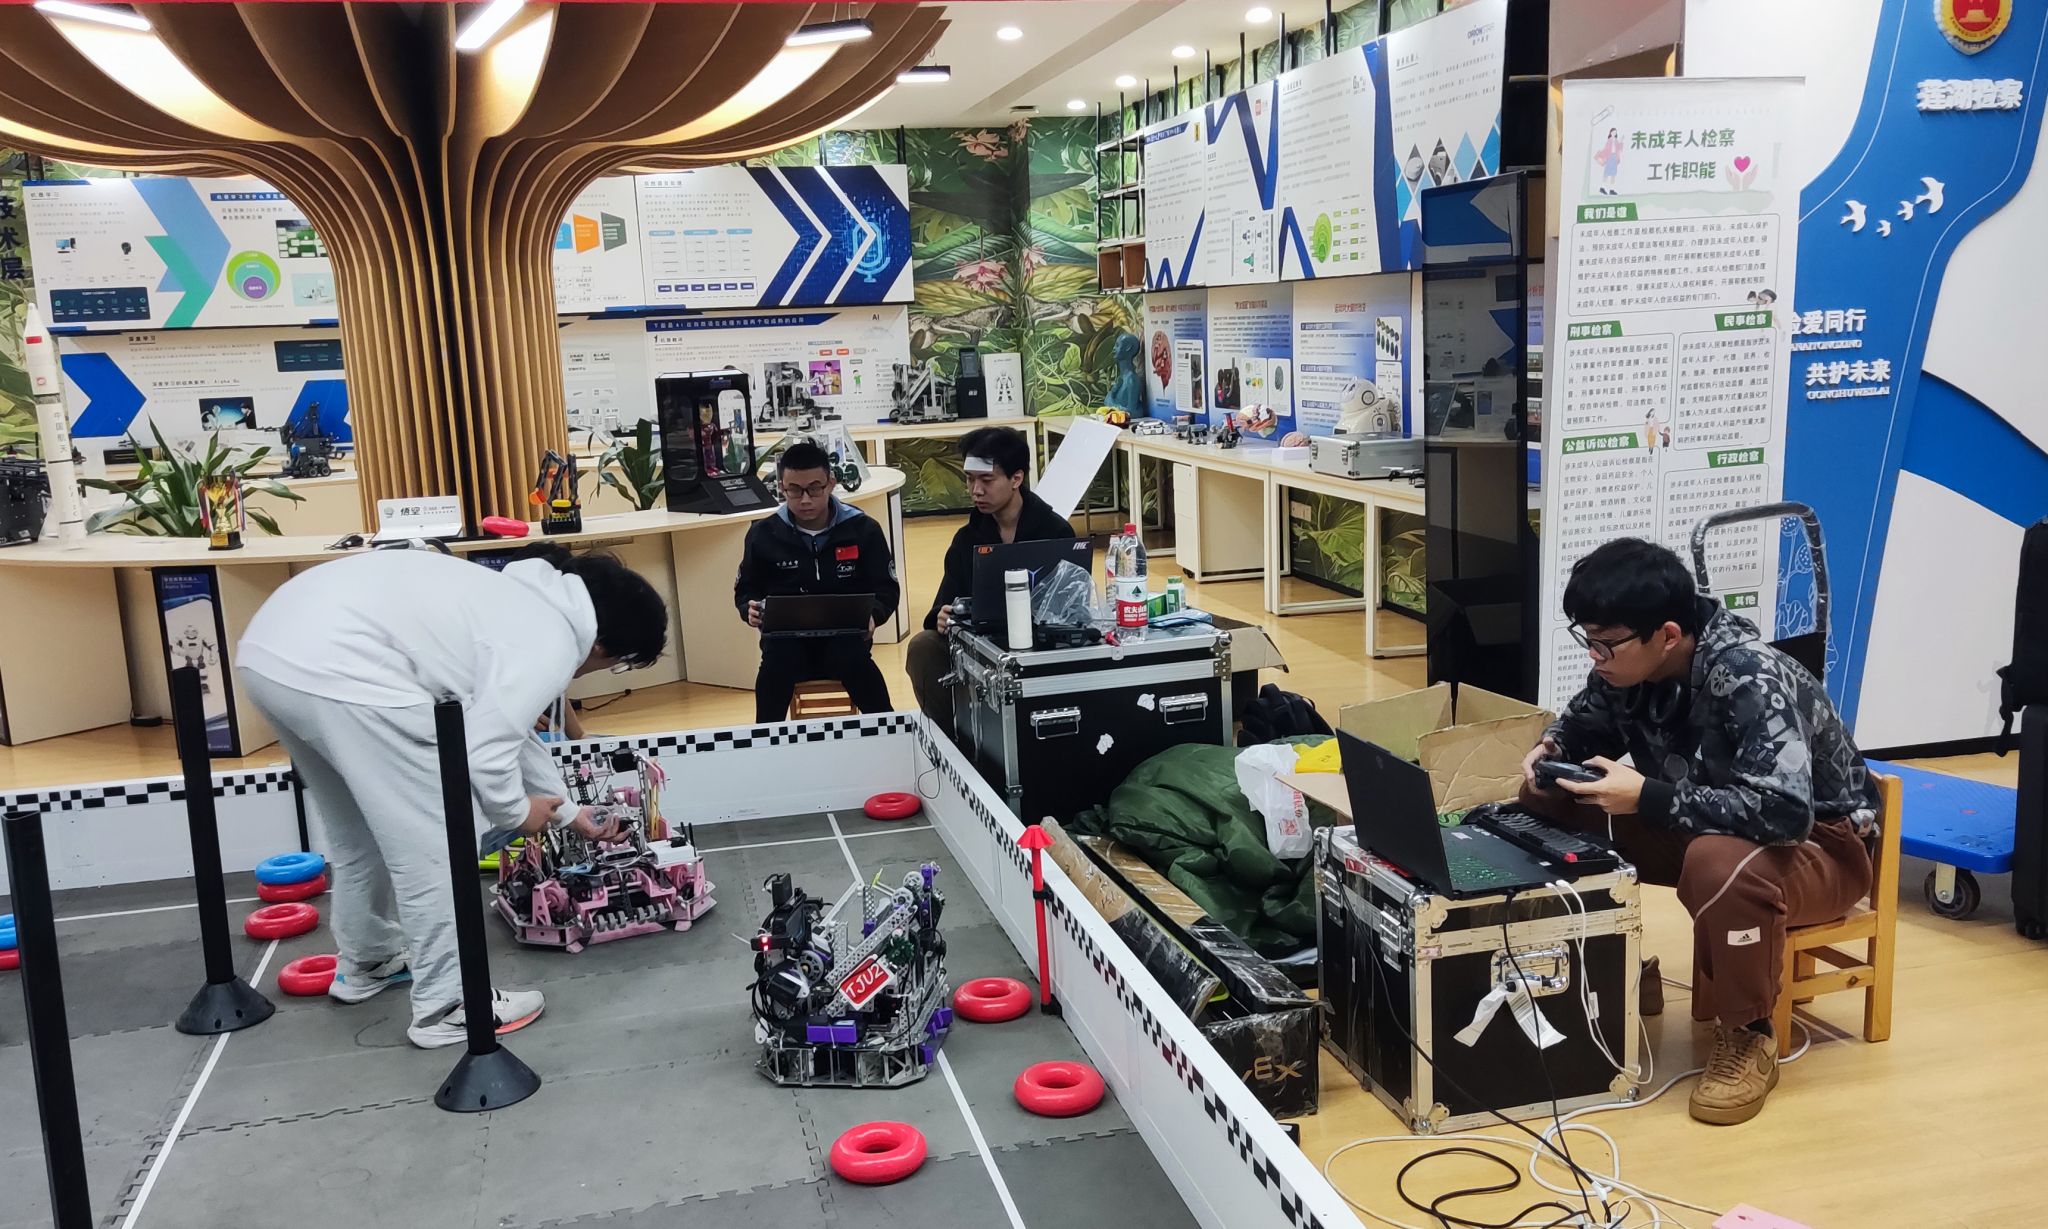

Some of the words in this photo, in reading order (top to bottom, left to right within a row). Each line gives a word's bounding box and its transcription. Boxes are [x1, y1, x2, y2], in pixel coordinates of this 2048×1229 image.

[1631, 128, 1735, 150] 未成年人检察
[1647, 161, 1717, 181] 工作职能
[872, 313, 880, 321] AI
[1723, 314, 1767, 328] 民事检察
[1806, 358, 1891, 386] 共护未来
[1564, 436, 1630, 452] 公益诉讼检察
[1717, 450, 1759, 464] 行政检察
[1734, 593, 1756, 608] 其他
